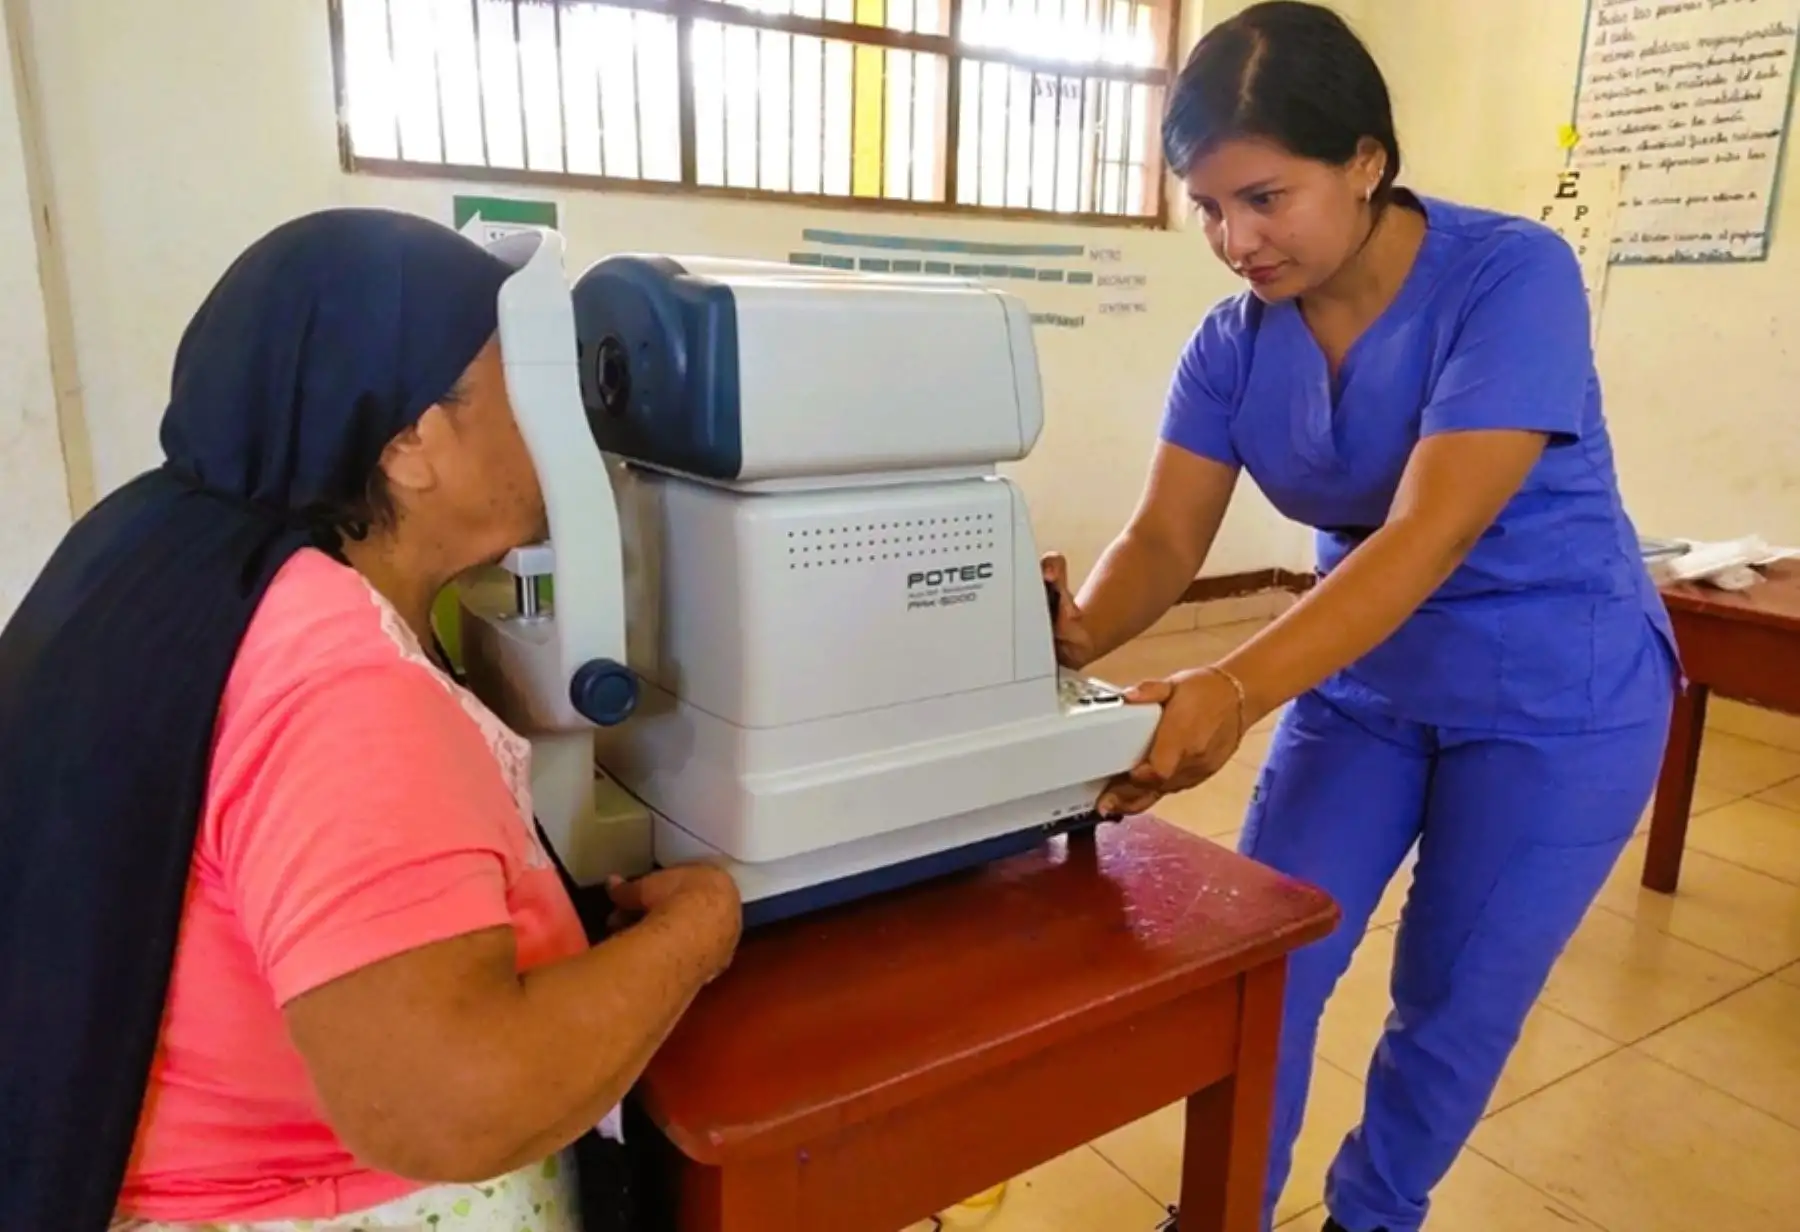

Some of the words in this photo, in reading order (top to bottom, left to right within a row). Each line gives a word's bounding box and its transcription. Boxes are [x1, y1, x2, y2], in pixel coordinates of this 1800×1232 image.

[1554, 171, 1580, 199] E
[1540, 205, 1554, 222] F
[1574, 205, 1589, 221] P
[907, 562, 993, 589] POTEC
